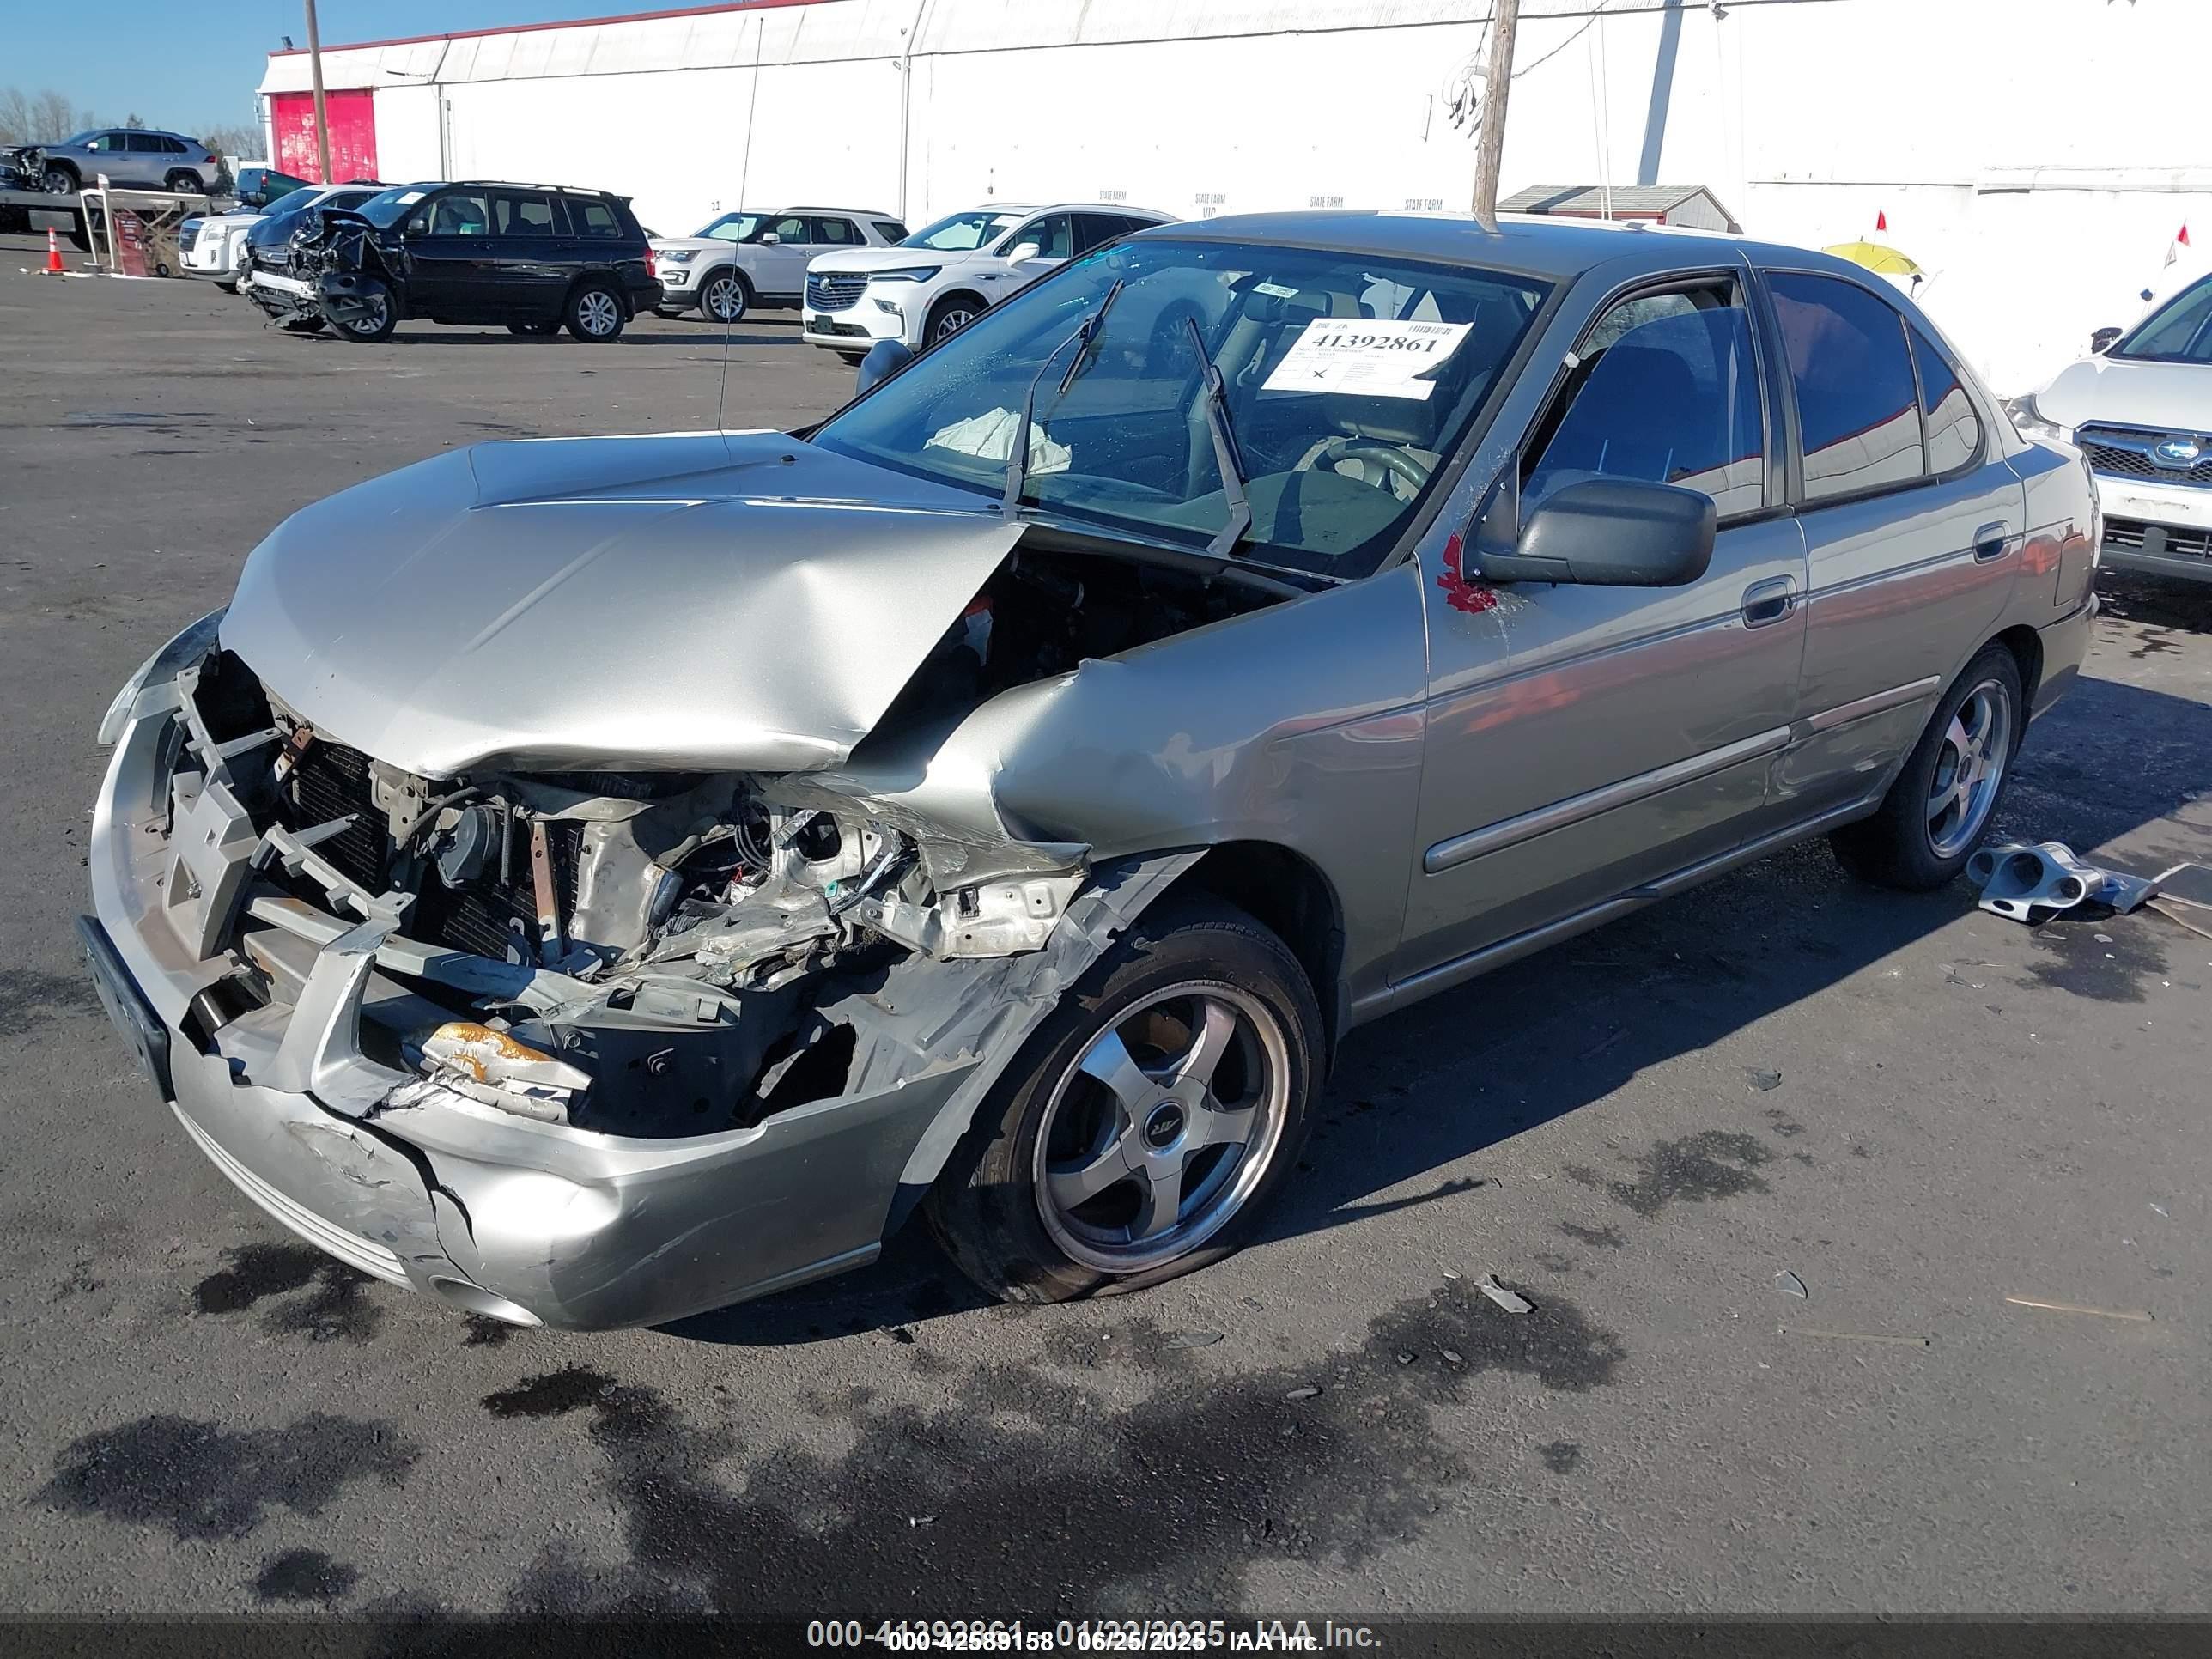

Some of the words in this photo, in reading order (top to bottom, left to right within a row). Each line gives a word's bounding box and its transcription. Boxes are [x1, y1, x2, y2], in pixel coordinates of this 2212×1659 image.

[1099, 190, 1112, 200] STATE
[1113, 191, 1127, 200] FARM
[1195, 192, 1210, 204] STATE
[1211, 193, 1226, 204] FARM
[1310, 196, 1326, 208] STATE
[1327, 197, 1343, 208] FARM
[1405, 198, 1422, 210] STATE
[1424, 199, 1443, 211] FARM
[1312, 334, 1437, 353] 41392861
